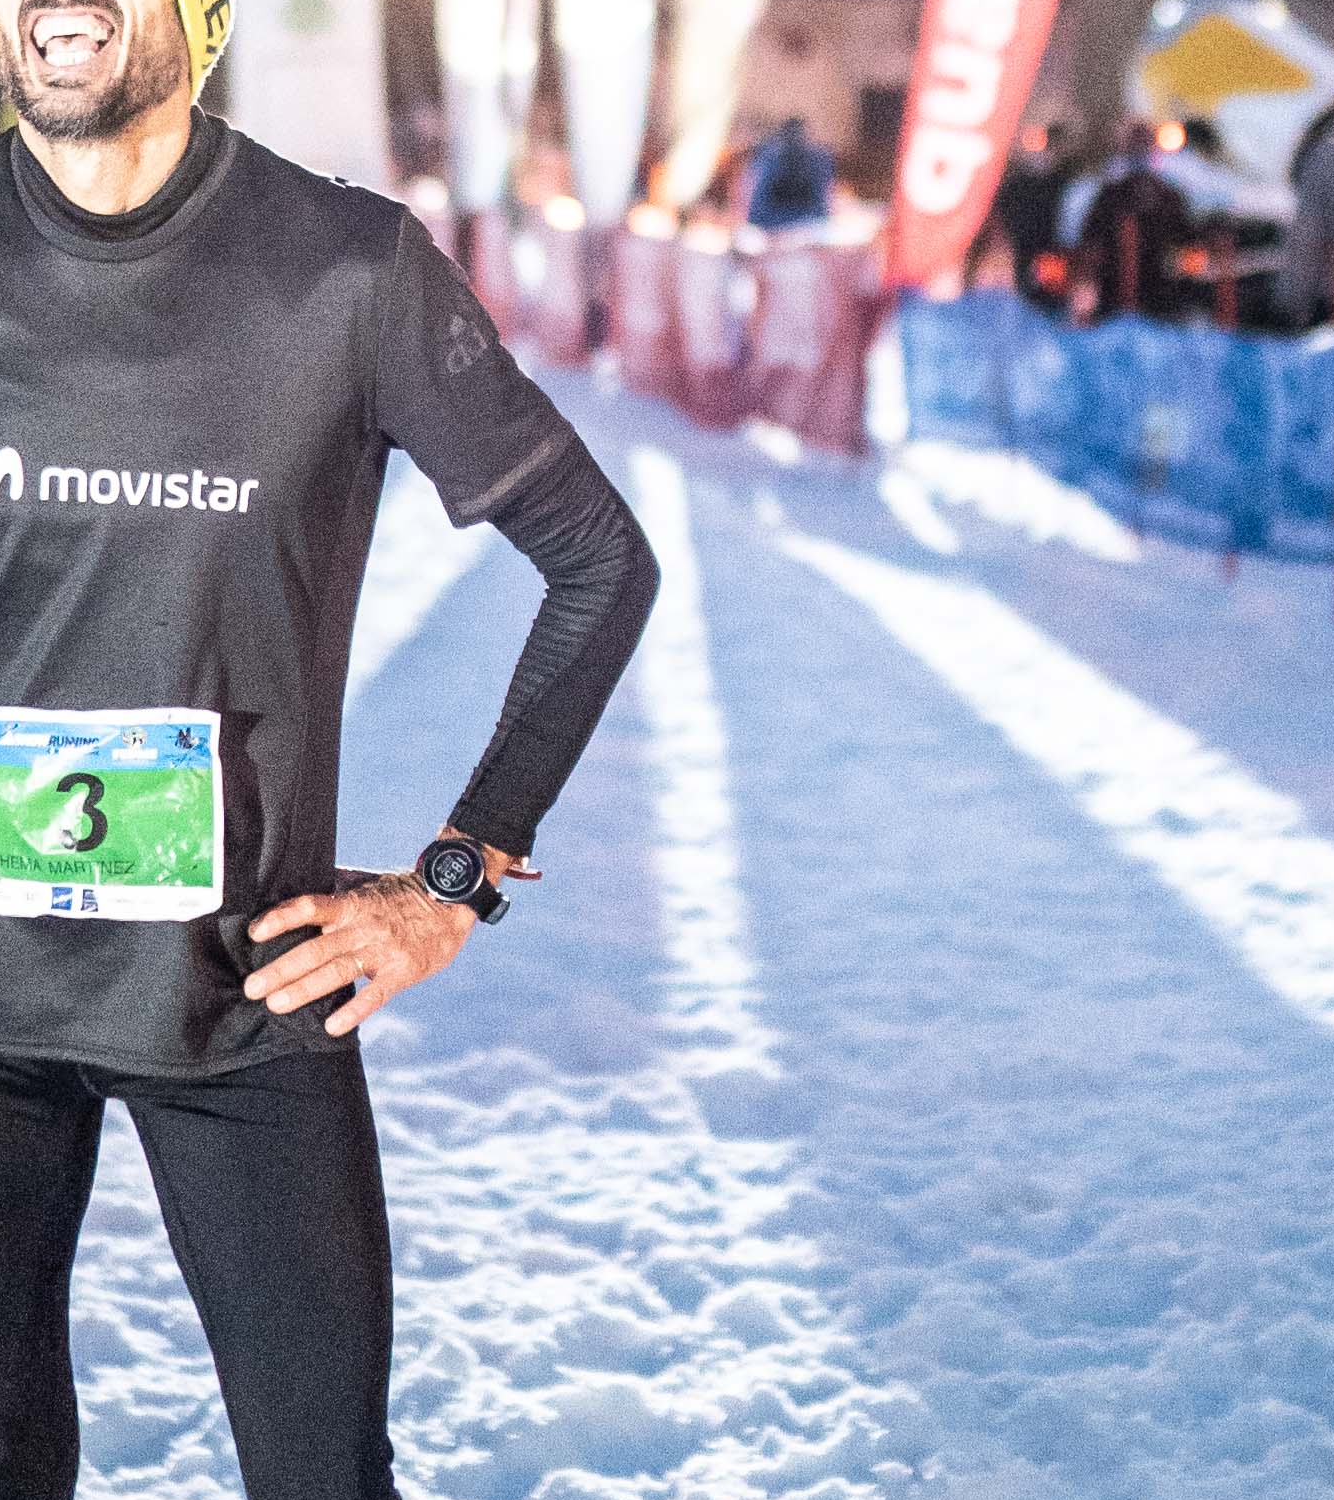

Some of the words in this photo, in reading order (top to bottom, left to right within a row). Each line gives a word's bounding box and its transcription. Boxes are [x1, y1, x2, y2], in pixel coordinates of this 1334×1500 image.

[40, 467, 260, 513] movistar
[56, 772, 108, 852] 3
[47, 859, 136, 876] MARTNEZ
